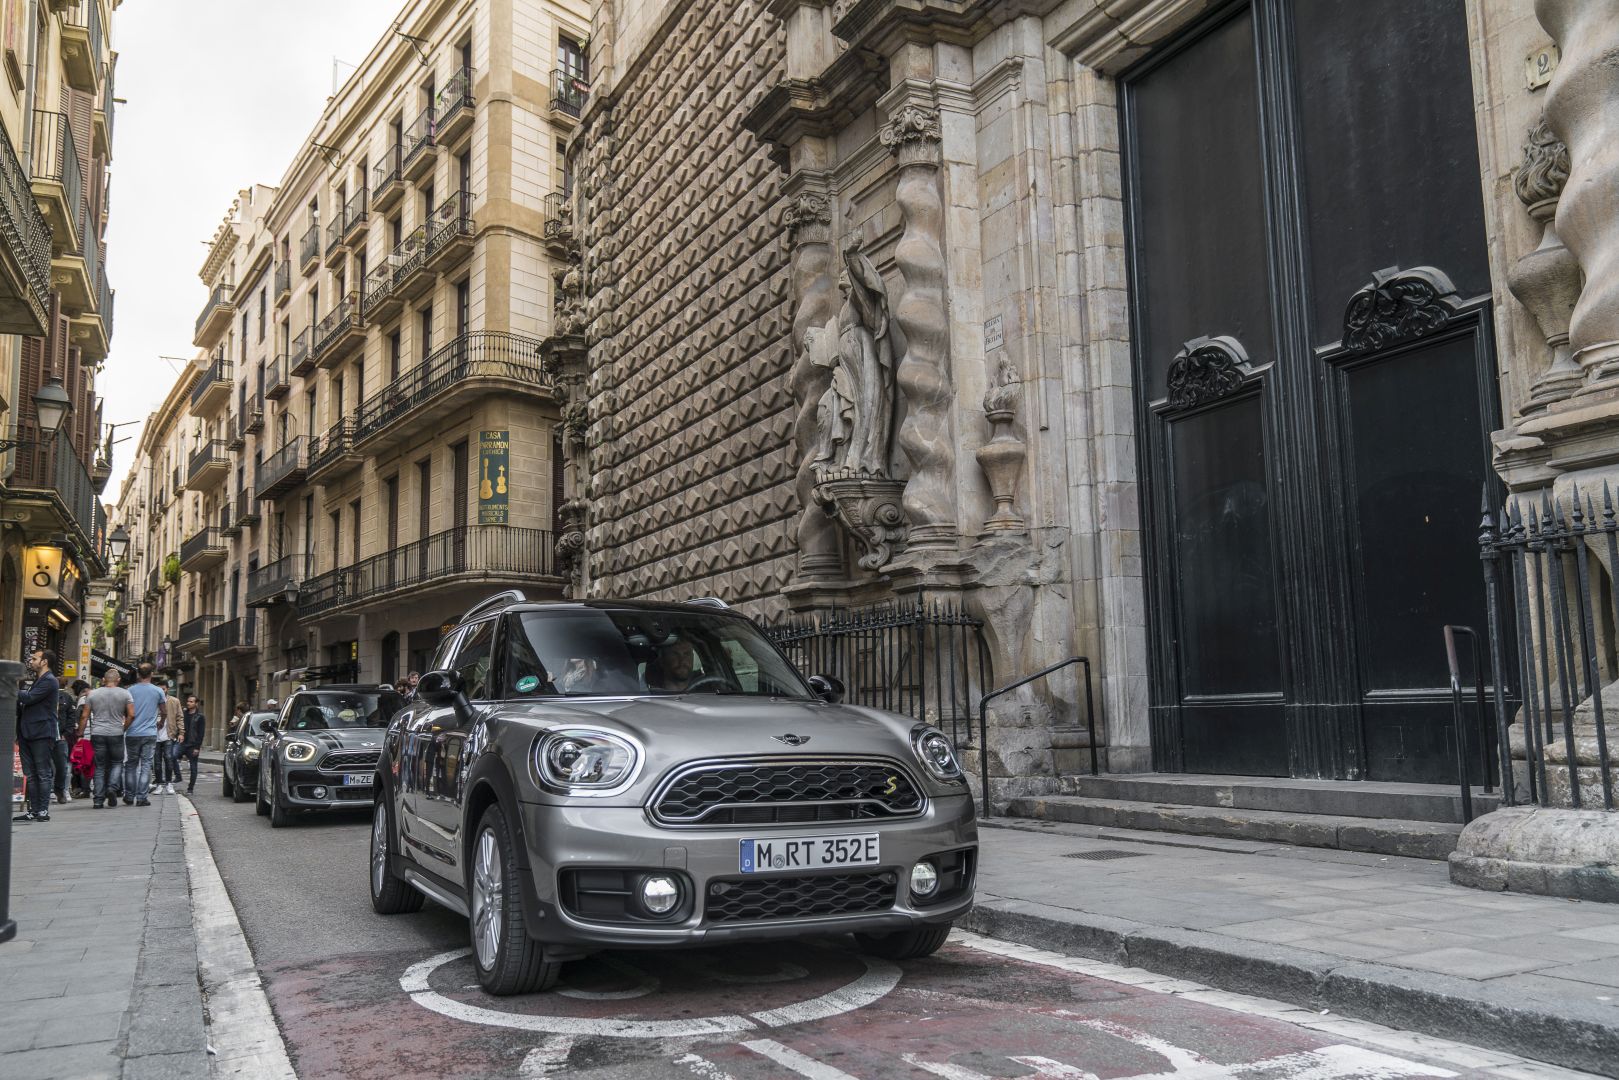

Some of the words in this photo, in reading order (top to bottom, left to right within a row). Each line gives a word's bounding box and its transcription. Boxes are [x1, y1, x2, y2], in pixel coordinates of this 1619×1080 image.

[1537, 53, 1550, 76] 2
[485, 431, 501, 439] CASA
[350, 776, 355, 784] M
[757, 842, 772, 868] M
[786, 841, 815, 866] RT
[821, 837, 878, 864] 352E
[744, 859, 751, 867] D
